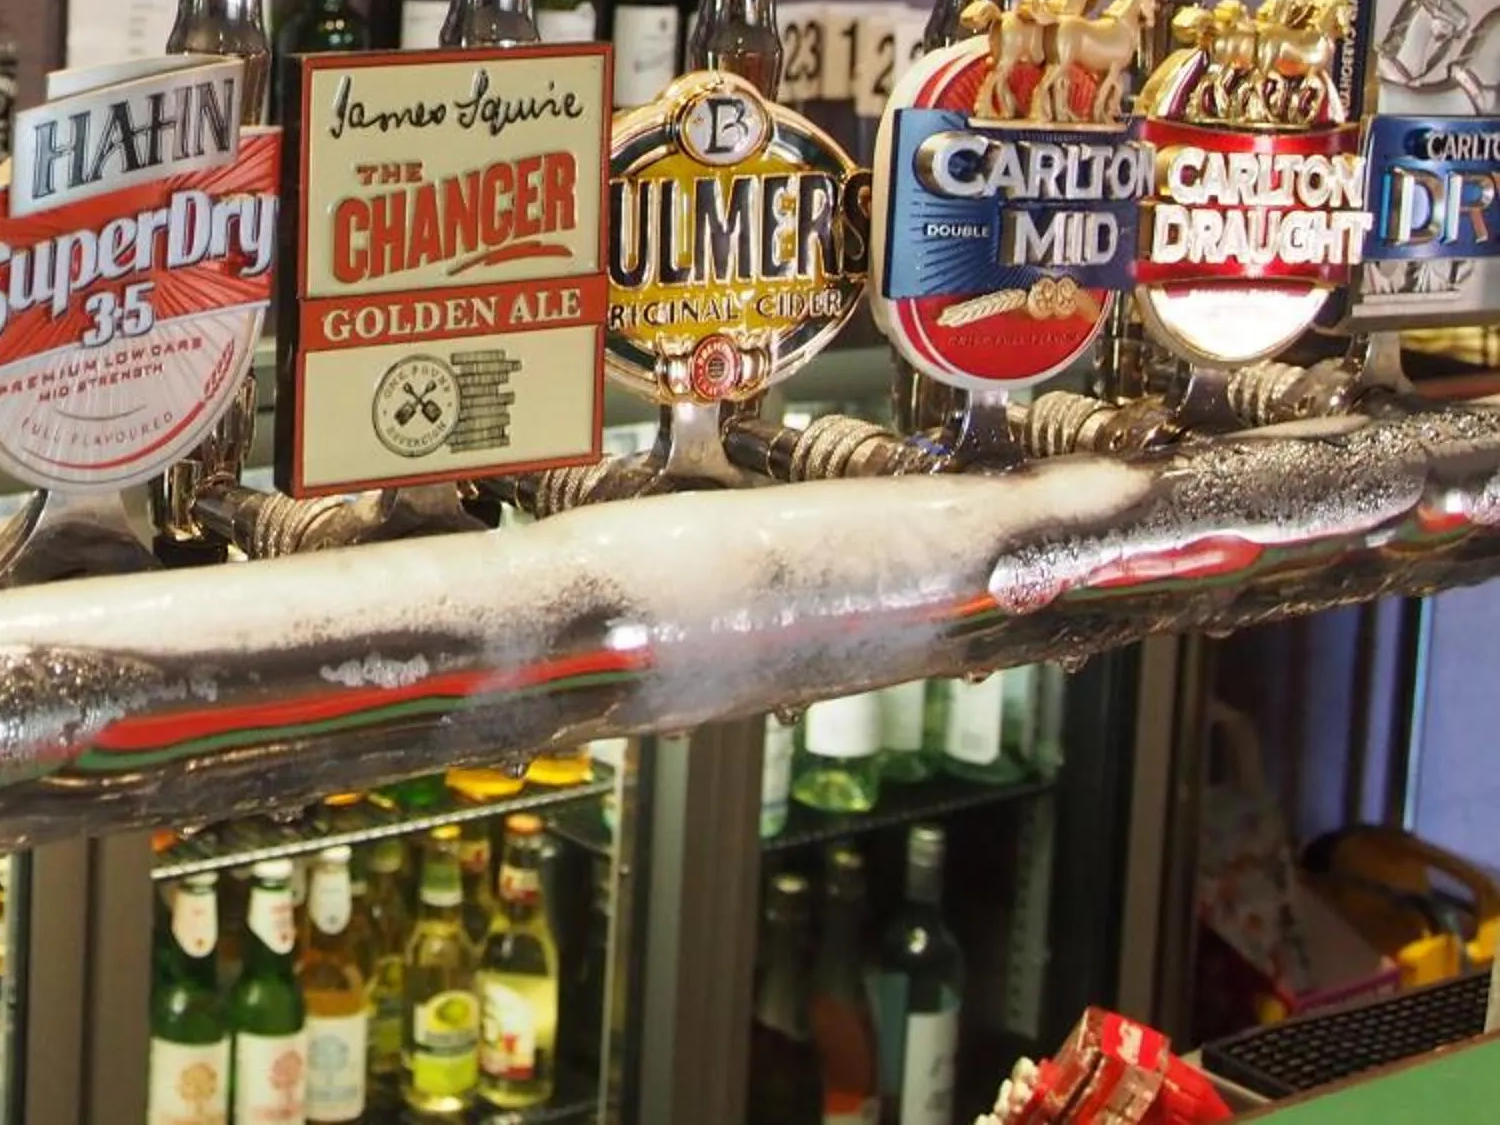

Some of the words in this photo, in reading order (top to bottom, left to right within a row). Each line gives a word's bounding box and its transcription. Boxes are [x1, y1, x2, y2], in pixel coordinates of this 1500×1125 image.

[330, 75, 446, 139] James
[454, 68, 585, 135] Squire
[32, 78, 236, 200] HAHN
[916, 130, 1155, 200] CARLTON
[356, 161, 423, 186] THE
[1167, 150, 1367, 208] CARLTON
[331, 150, 577, 285] CHANCER
[608, 171, 872, 290] ULMERS
[1151, 204, 1373, 265] DRAUGHT
[1382, 167, 1500, 245] DR
[924, 223, 990, 238] DOUBLE
[1012, 210, 1119, 266] MID
[323, 295, 498, 342] GOLDEN
[508, 287, 582, 323] ALE
[609, 297, 740, 330] RIGINAL
[756, 288, 843, 321] CIDER
[77, 362, 164, 394] STRENGTH
[104, 347, 145, 367] LOW
[151, 337, 203, 357] CARB
